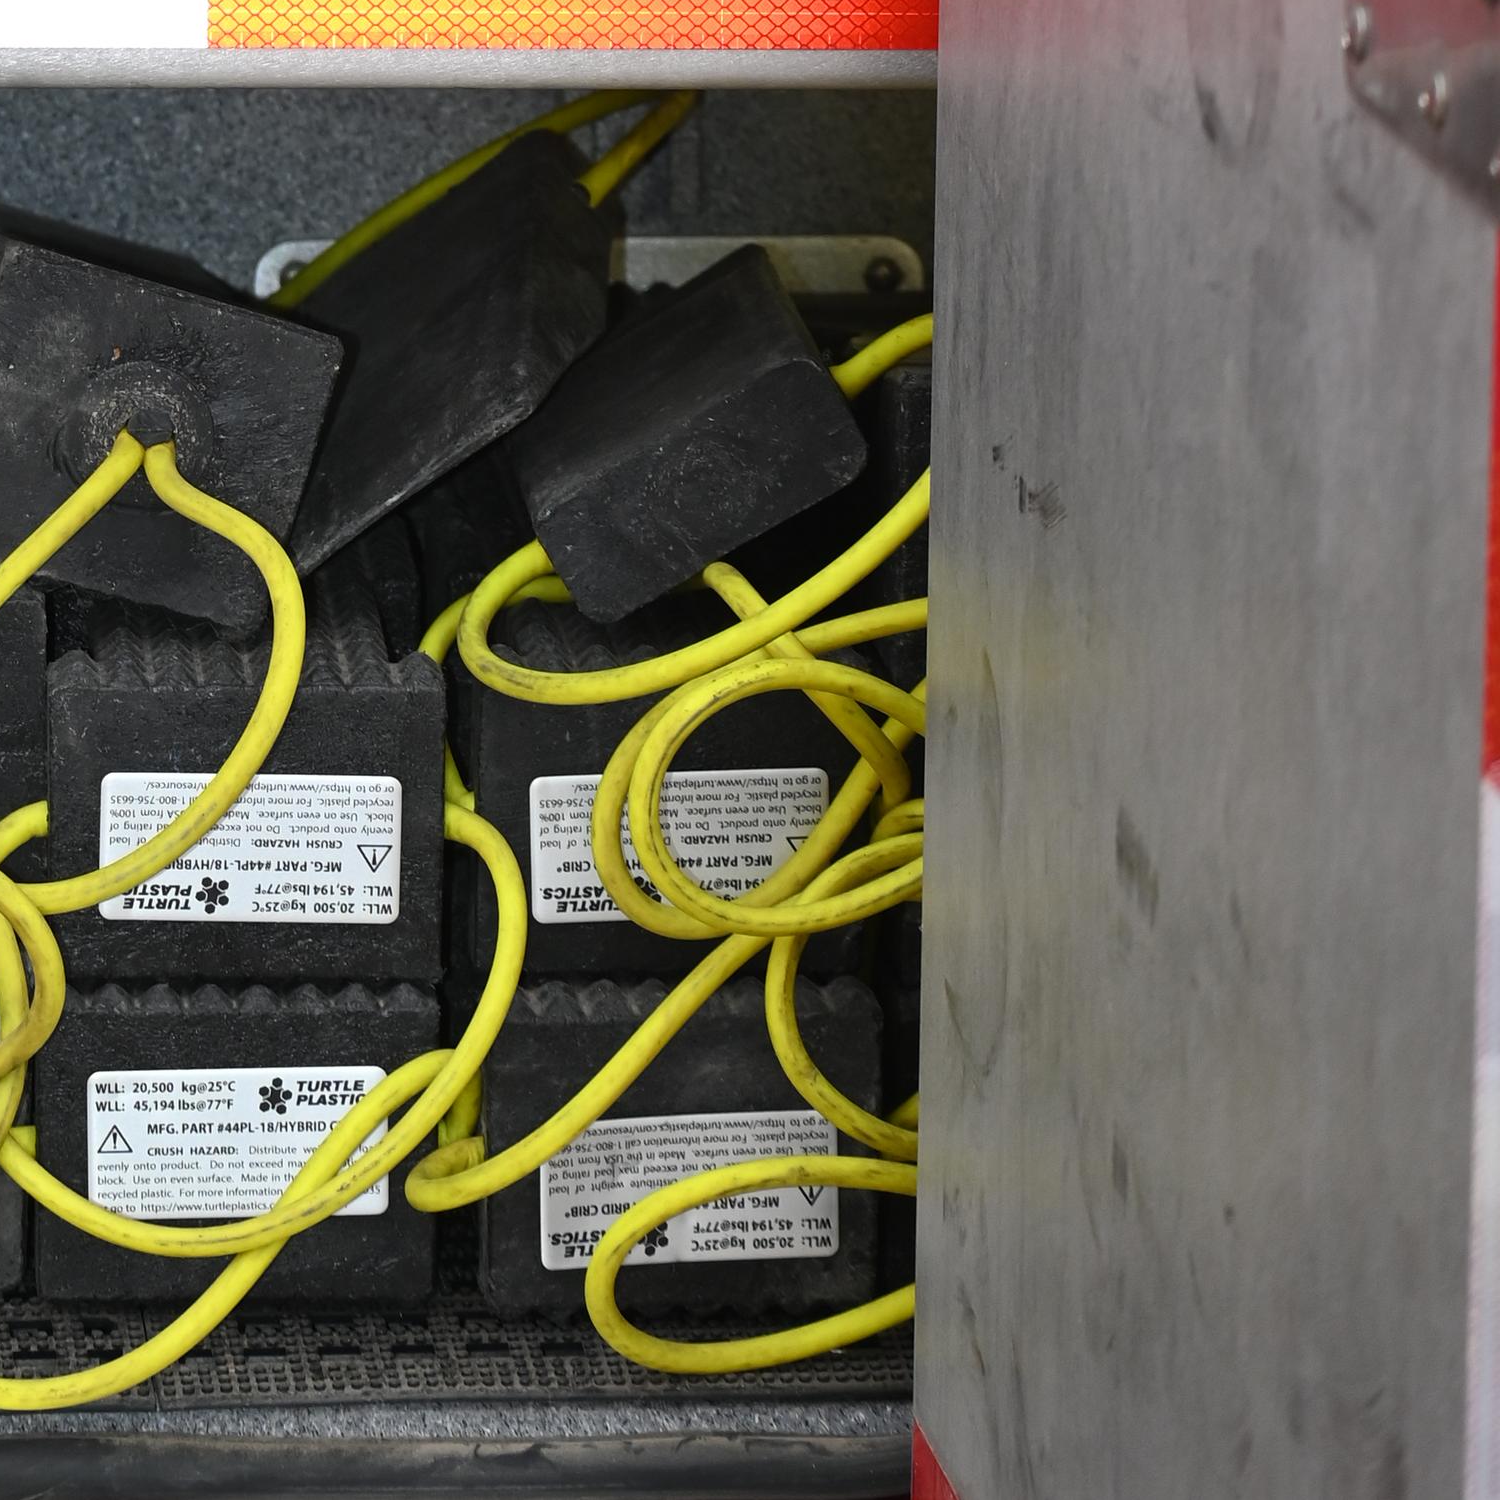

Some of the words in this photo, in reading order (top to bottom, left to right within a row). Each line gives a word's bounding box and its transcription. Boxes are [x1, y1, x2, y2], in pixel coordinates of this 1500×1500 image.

[251, 839, 300, 848] HAZARD:
[306, 840, 343, 849] CRUSH
[681, 834, 730, 845] HAZARD:
[736, 834, 772, 843] CRUSH
[275, 861, 308, 872] PART
[310, 861, 342, 872] MFG.
[706, 856, 738, 867] PART
[741, 855, 773, 866] MFG.
[255, 883, 310, 896] lbs@77°F
[313, 883, 355, 896] 45,194
[363, 885, 393, 897] WLL:
[540, 886, 612, 900] ASTICS.
[123, 898, 191, 910] TURTLE
[252, 899, 306, 914] kg@25°C
[314, 901, 355, 913] 20,500
[362, 904, 393, 915] WLL:
[95, 1083, 125, 1094] WLL:
[132, 1082, 174, 1094] 20,500
[182, 1081, 236, 1095] kg@25°C
[297, 1080, 365, 1092] TURTLE
[95, 1101, 125, 1112] WLL:
[133, 1100, 175, 1112] 45,194
[178, 1099, 234, 1112] lbs@77°F
[296, 1094, 365, 1106] PLASTIC
[148, 1123, 179, 1135] MFG.
[182, 1123, 214, 1134] PART
[217, 1121, 326, 1134] #44PL-18/HYBRID
[148, 1147, 184, 1157] CRUSH
[190, 1146, 239, 1155] HAZARD:
[249, 1145, 297, 1155] Distribute
[97, 1162, 129, 1172] evenly
[133, 1161, 157, 1171] onto
[161, 1161, 202, 1172] product.
[210, 1160, 224, 1169] Do
[229, 1160, 245, 1169] not
[249, 1159, 284, 1169] exceed
[712, 1197, 745, 1209] PART
[748, 1197, 779, 1208] MFG.
[752, 1218, 793, 1231] 45,194
[801, 1218, 832, 1230] WLL:
[753, 1237, 794, 1249] 20,500
[801, 1236, 832, 1248] WLL:
